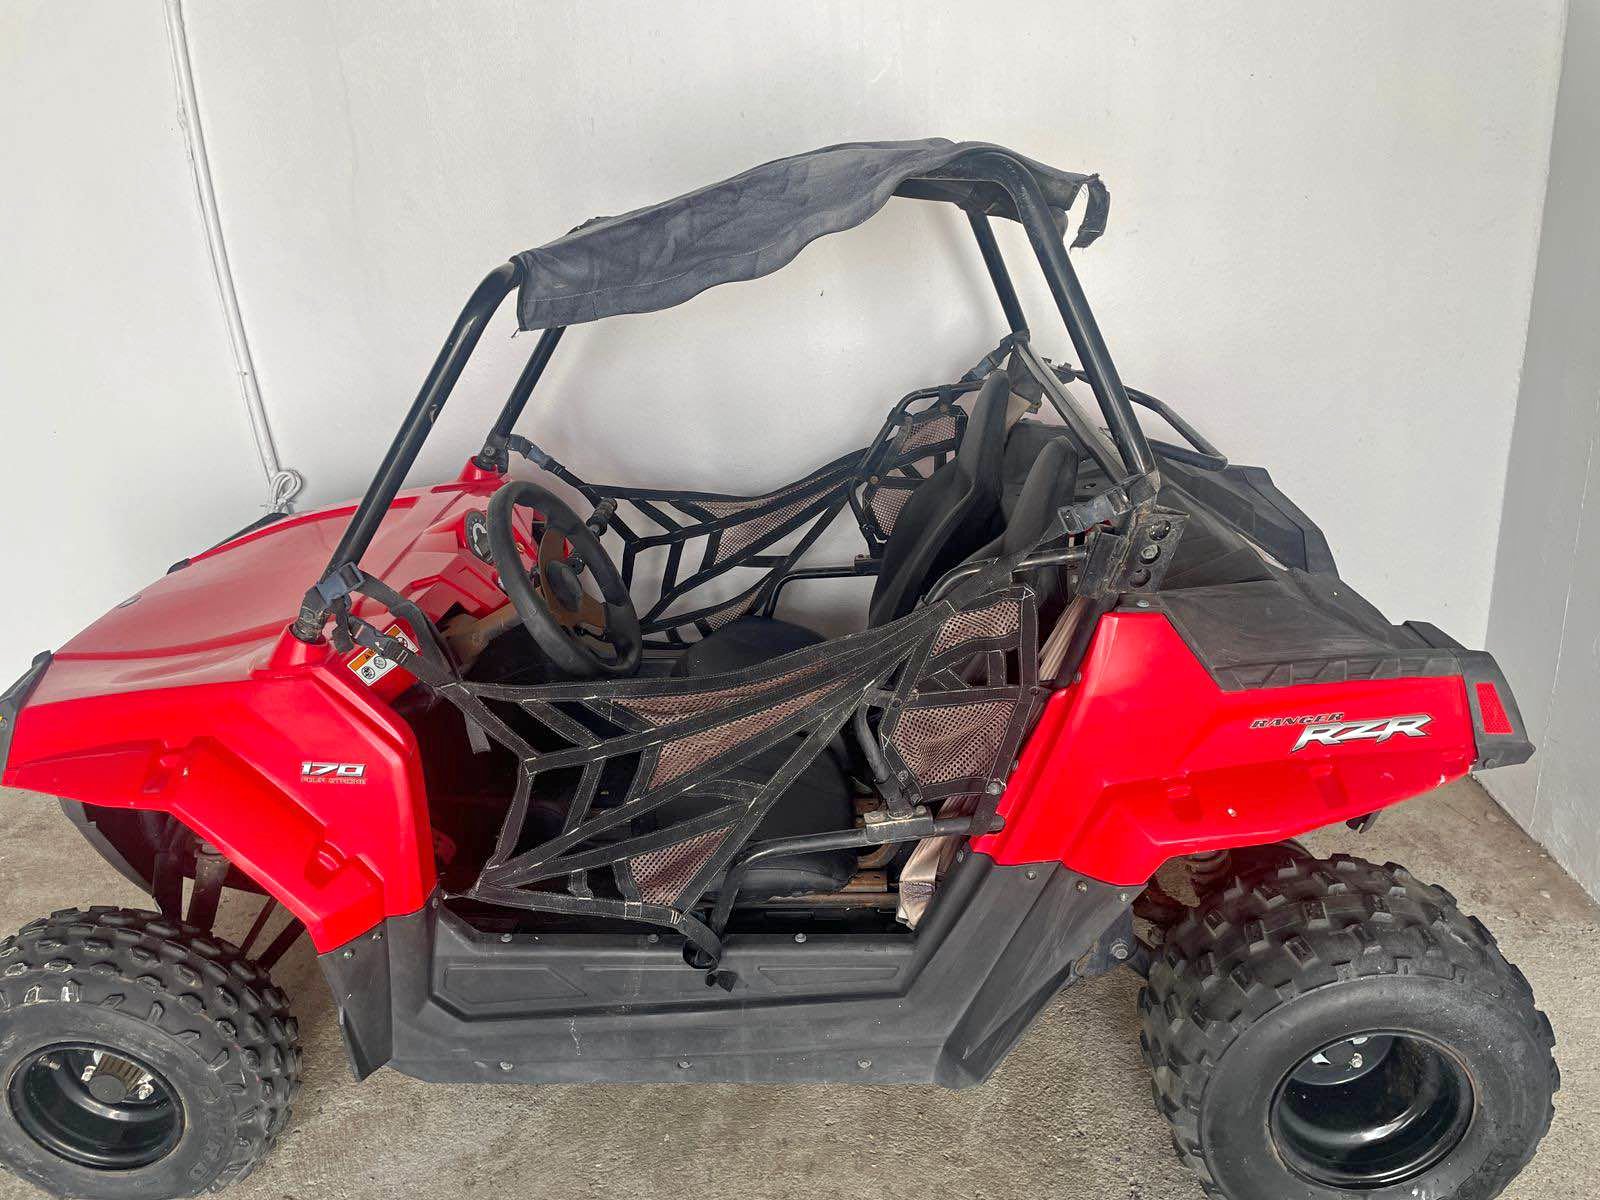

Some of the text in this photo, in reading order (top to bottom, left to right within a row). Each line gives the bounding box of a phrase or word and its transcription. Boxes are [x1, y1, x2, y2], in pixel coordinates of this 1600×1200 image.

[1250, 711, 1345, 729] RANGER
[1290, 713, 1433, 754] RZR
[301, 761, 367, 777] 170
